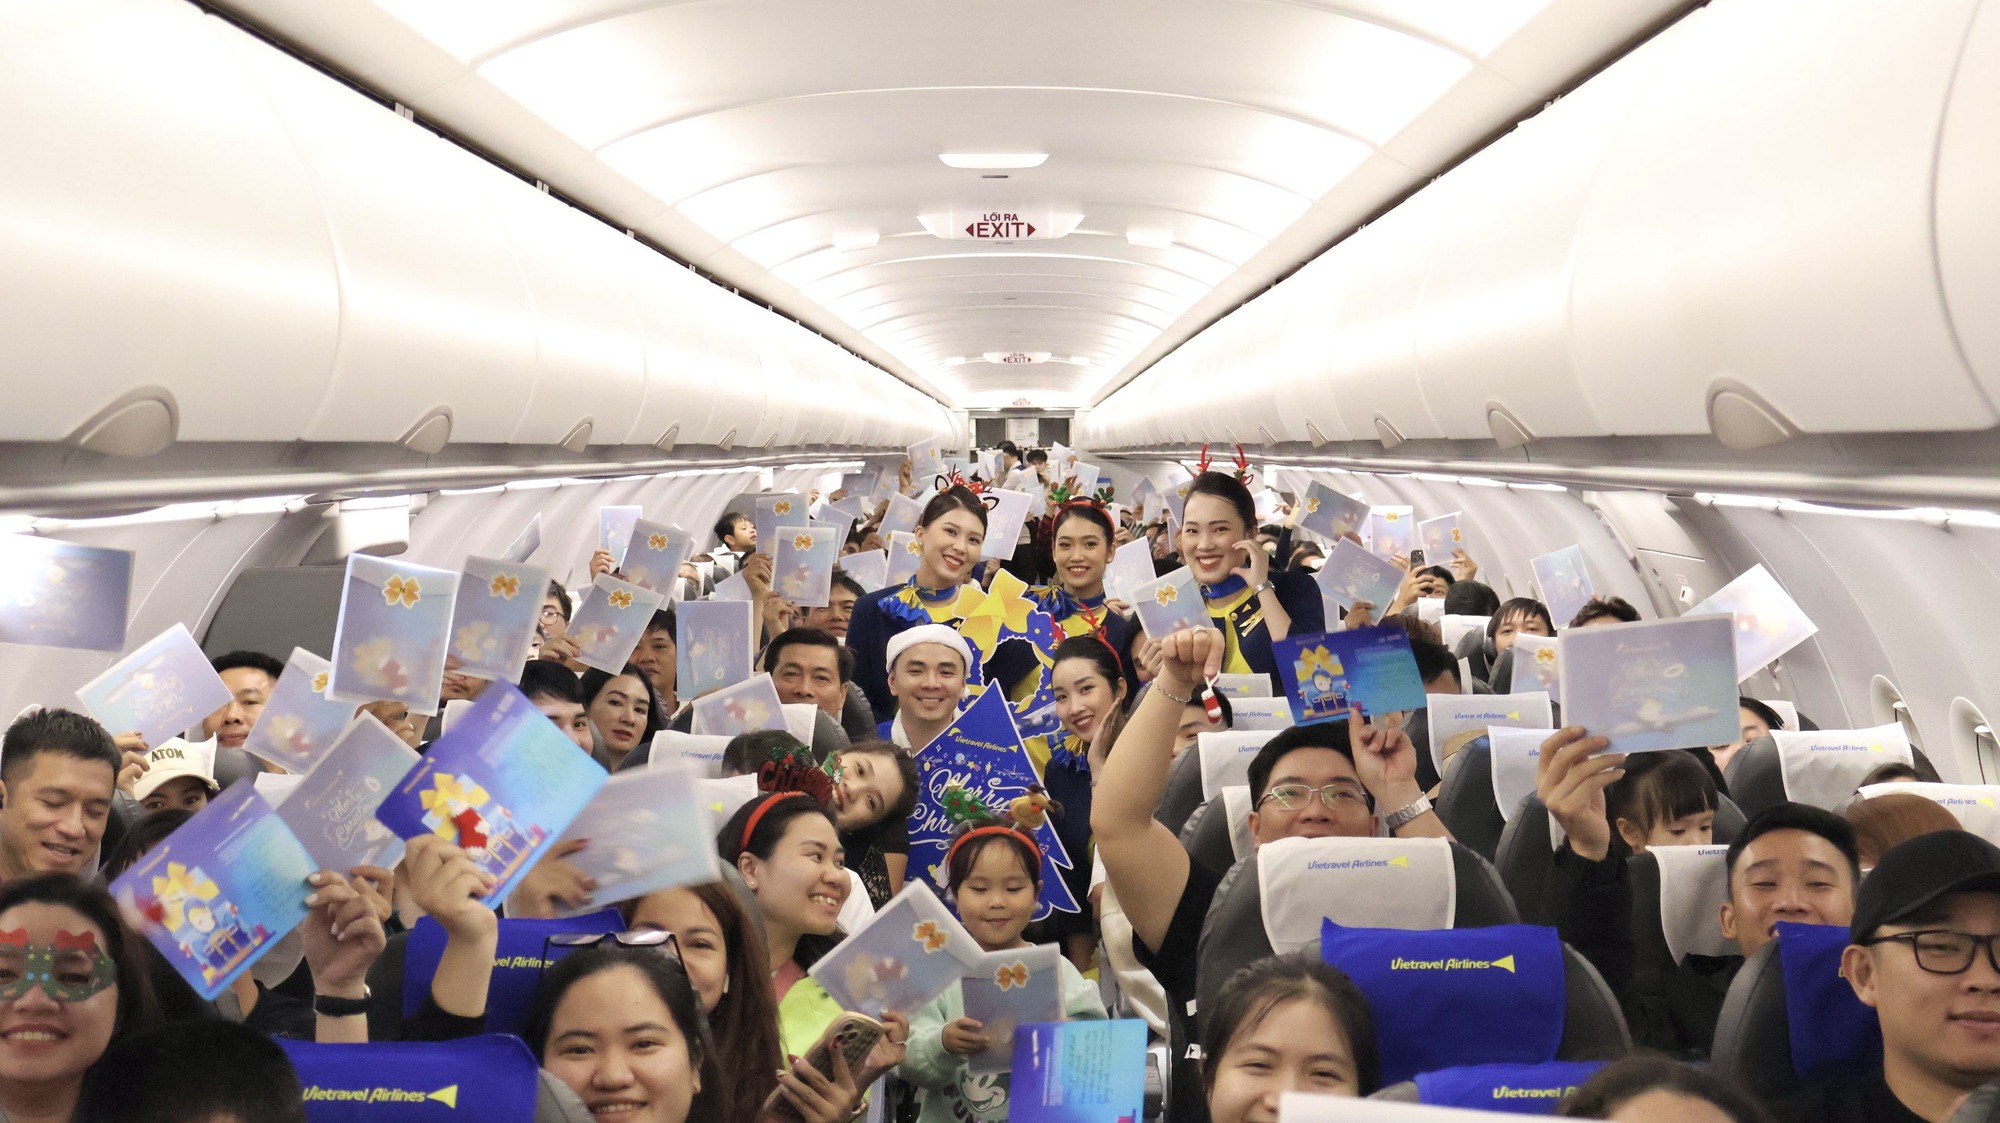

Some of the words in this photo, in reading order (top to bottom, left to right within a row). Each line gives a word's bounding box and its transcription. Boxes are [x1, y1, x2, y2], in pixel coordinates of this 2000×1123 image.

[1004, 213, 1018, 221] RA
[977, 222, 1025, 238] EXIT
[955, 735, 984, 747] Vietravel
[983, 742, 1007, 752] Airlines
[151, 748, 185, 763] ATOM
[1308, 860, 1350, 870] Vietravel
[1351, 859, 1388, 870] Airlines
[1391, 957, 1444, 970] Vietravel
[1445, 958, 1490, 971] Airlines
[302, 1085, 369, 1101] Vietravel
[368, 1087, 426, 1104] Airlines
[1493, 1085, 1562, 1099] Vietravel
